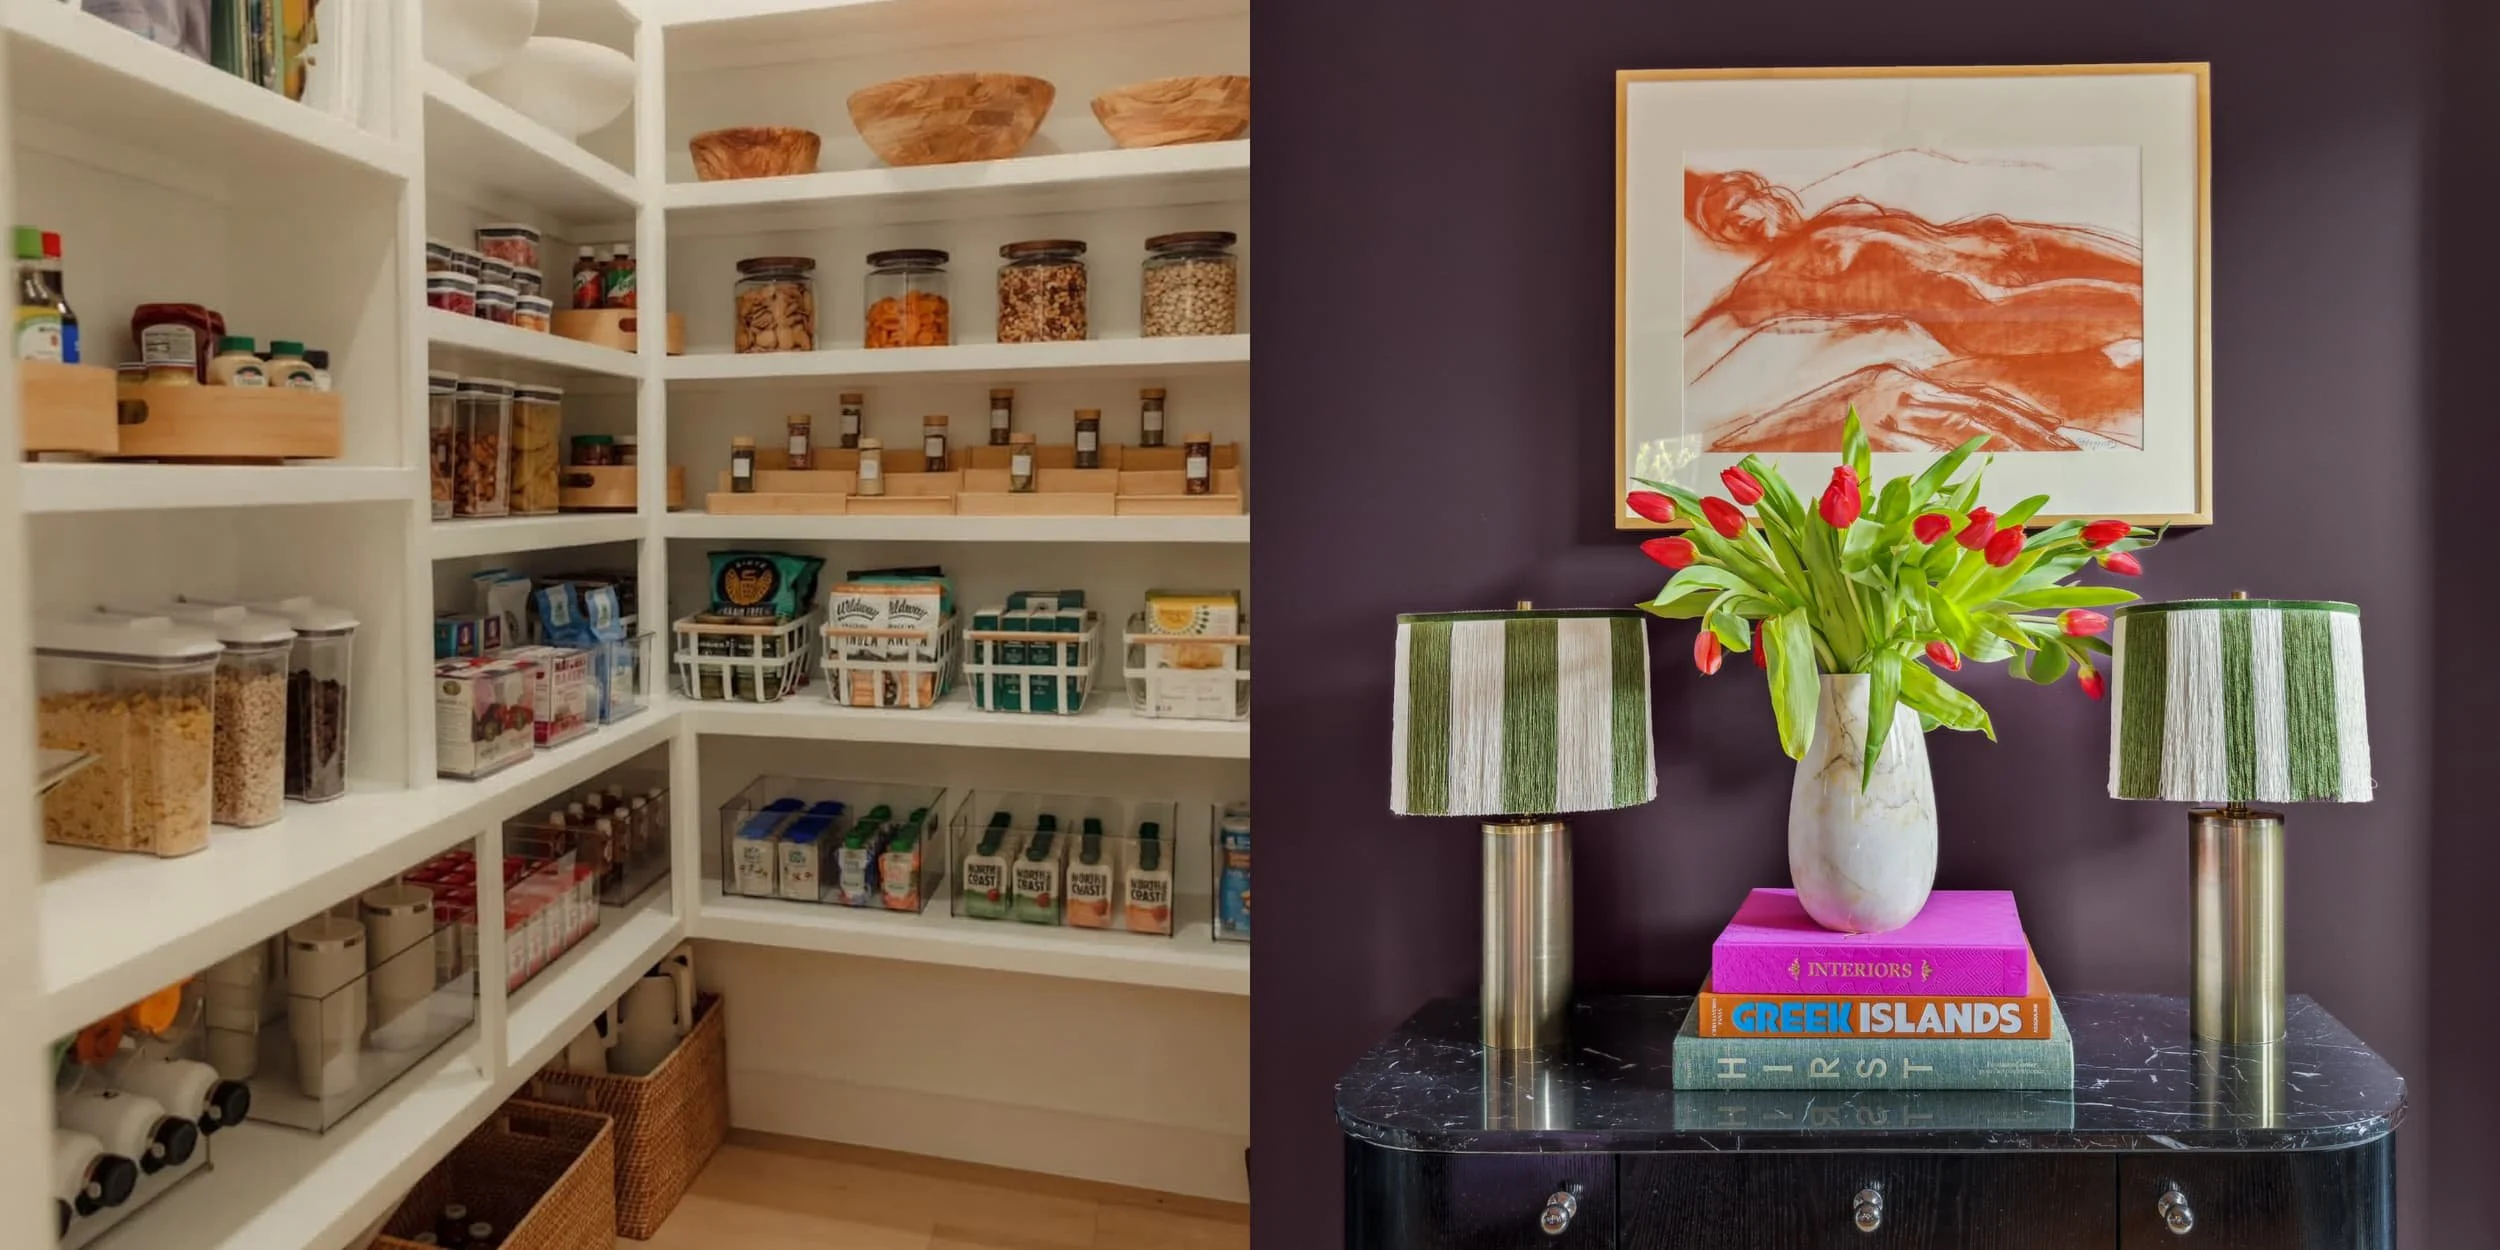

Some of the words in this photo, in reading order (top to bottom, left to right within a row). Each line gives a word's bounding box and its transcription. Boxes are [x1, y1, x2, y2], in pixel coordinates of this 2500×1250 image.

[889, 598, 929, 617] ildway
[967, 873, 996, 887] COAST
[1017, 879, 1045, 892] COAST
[1071, 883, 1101, 897] COAST
[1130, 889, 1161, 903] COAST
[1807, 961, 1913, 979] INTERIORS
[1731, 1001, 1854, 1034] GREEK
[1859, 1002, 2023, 1034] ISLANDS
[1717, 1057, 1934, 1079] HIRST
